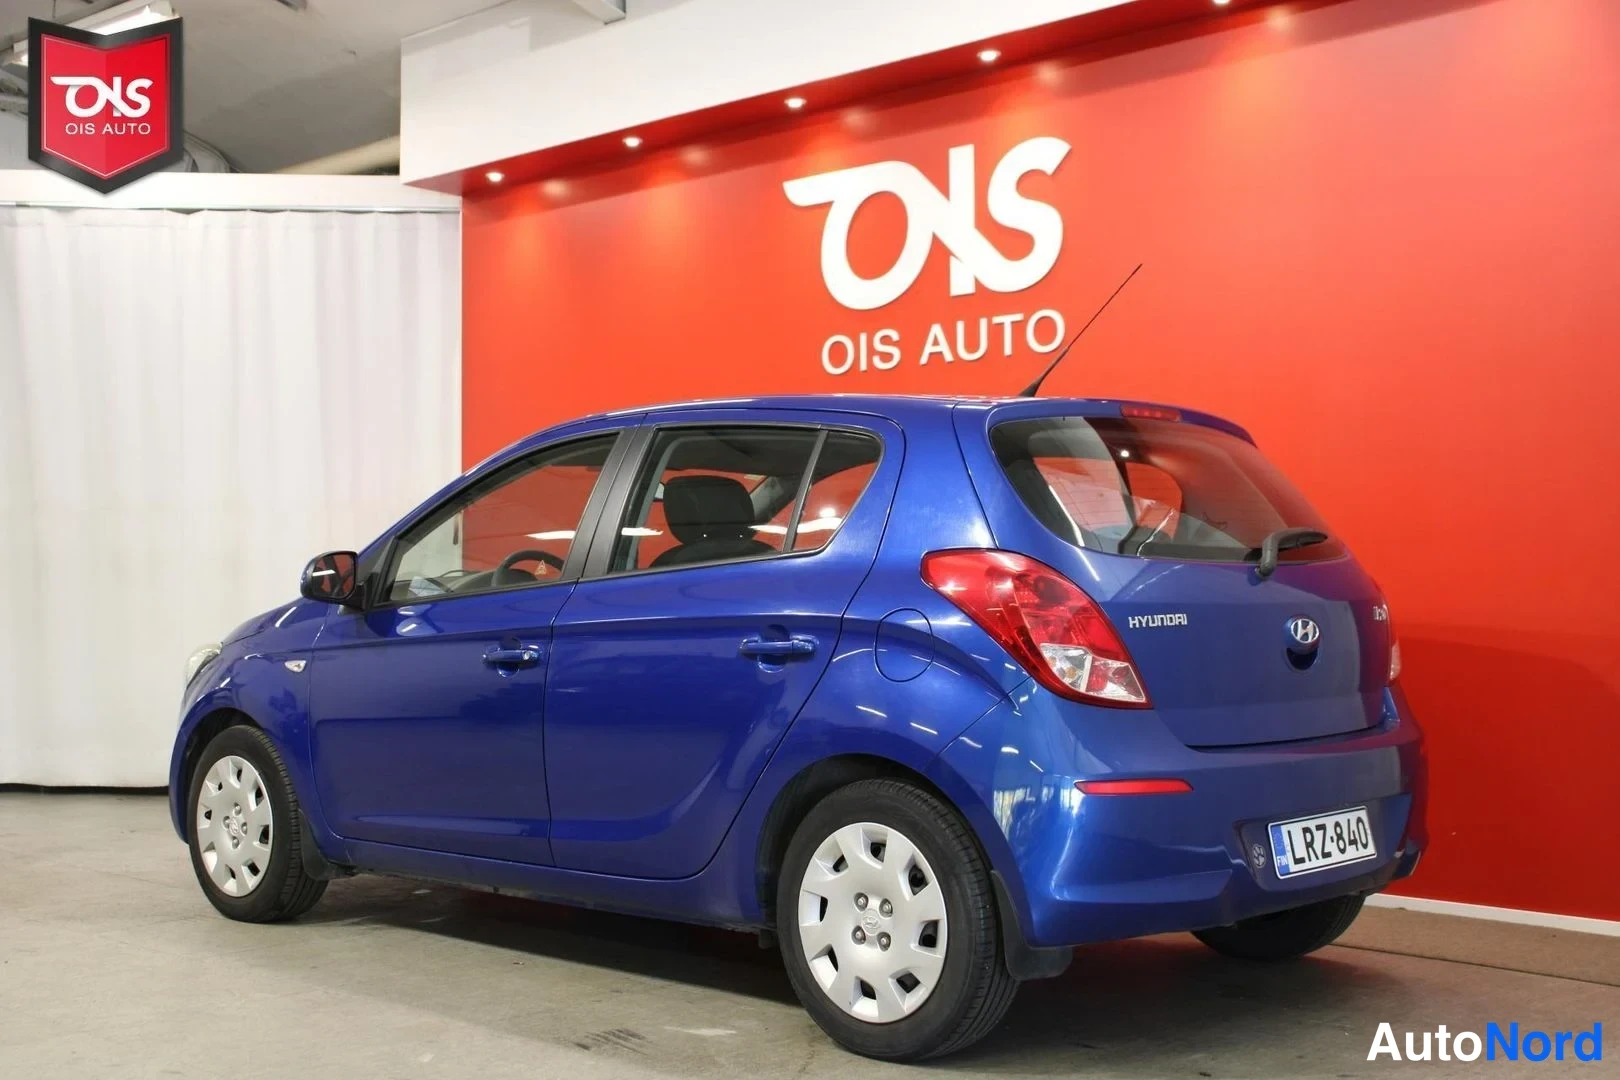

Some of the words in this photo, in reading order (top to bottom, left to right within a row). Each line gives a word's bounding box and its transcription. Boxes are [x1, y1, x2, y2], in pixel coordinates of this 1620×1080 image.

[821, 329, 901, 375] OIS
[919, 309, 1065, 365] AUTO
[1128, 613, 1188, 628] HYUNDAI
